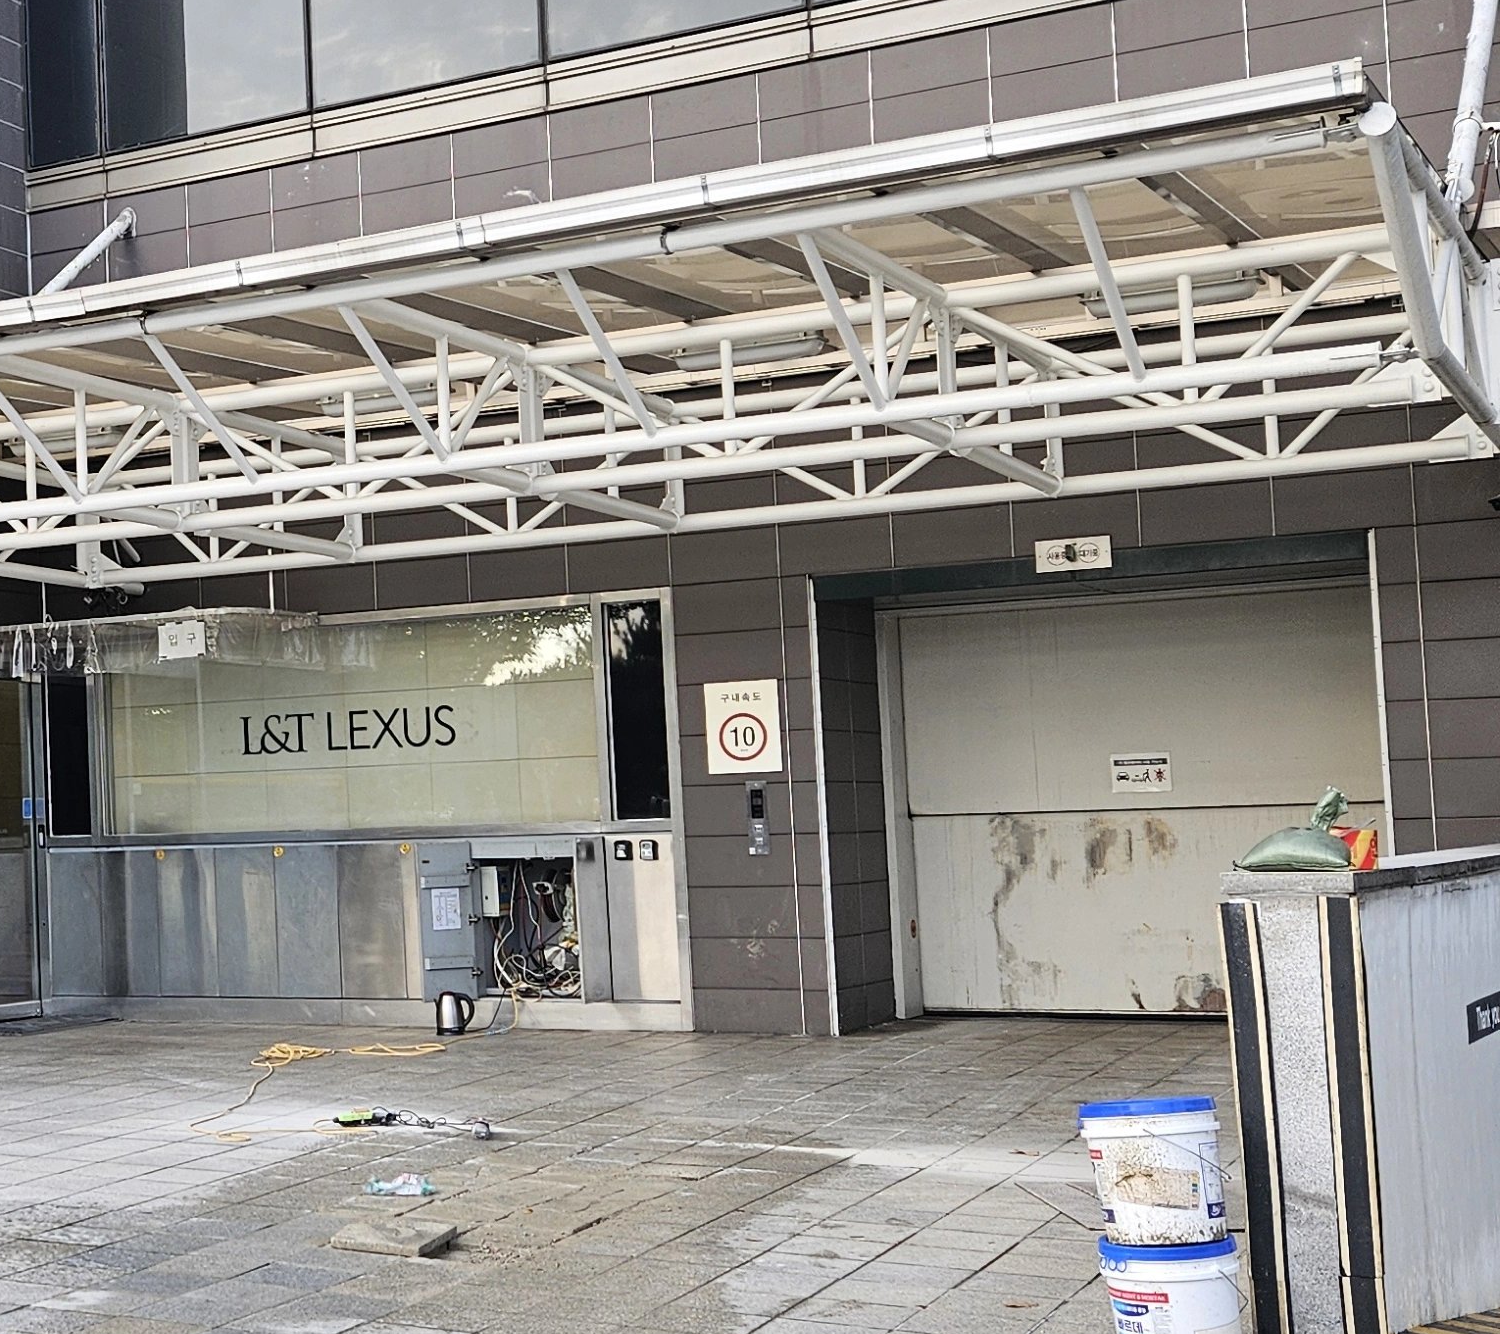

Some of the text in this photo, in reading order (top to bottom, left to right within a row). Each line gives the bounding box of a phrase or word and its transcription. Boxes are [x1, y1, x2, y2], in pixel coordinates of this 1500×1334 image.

[239, 705, 457, 756] L&T LEXUS
[730, 726, 756, 747] 10
